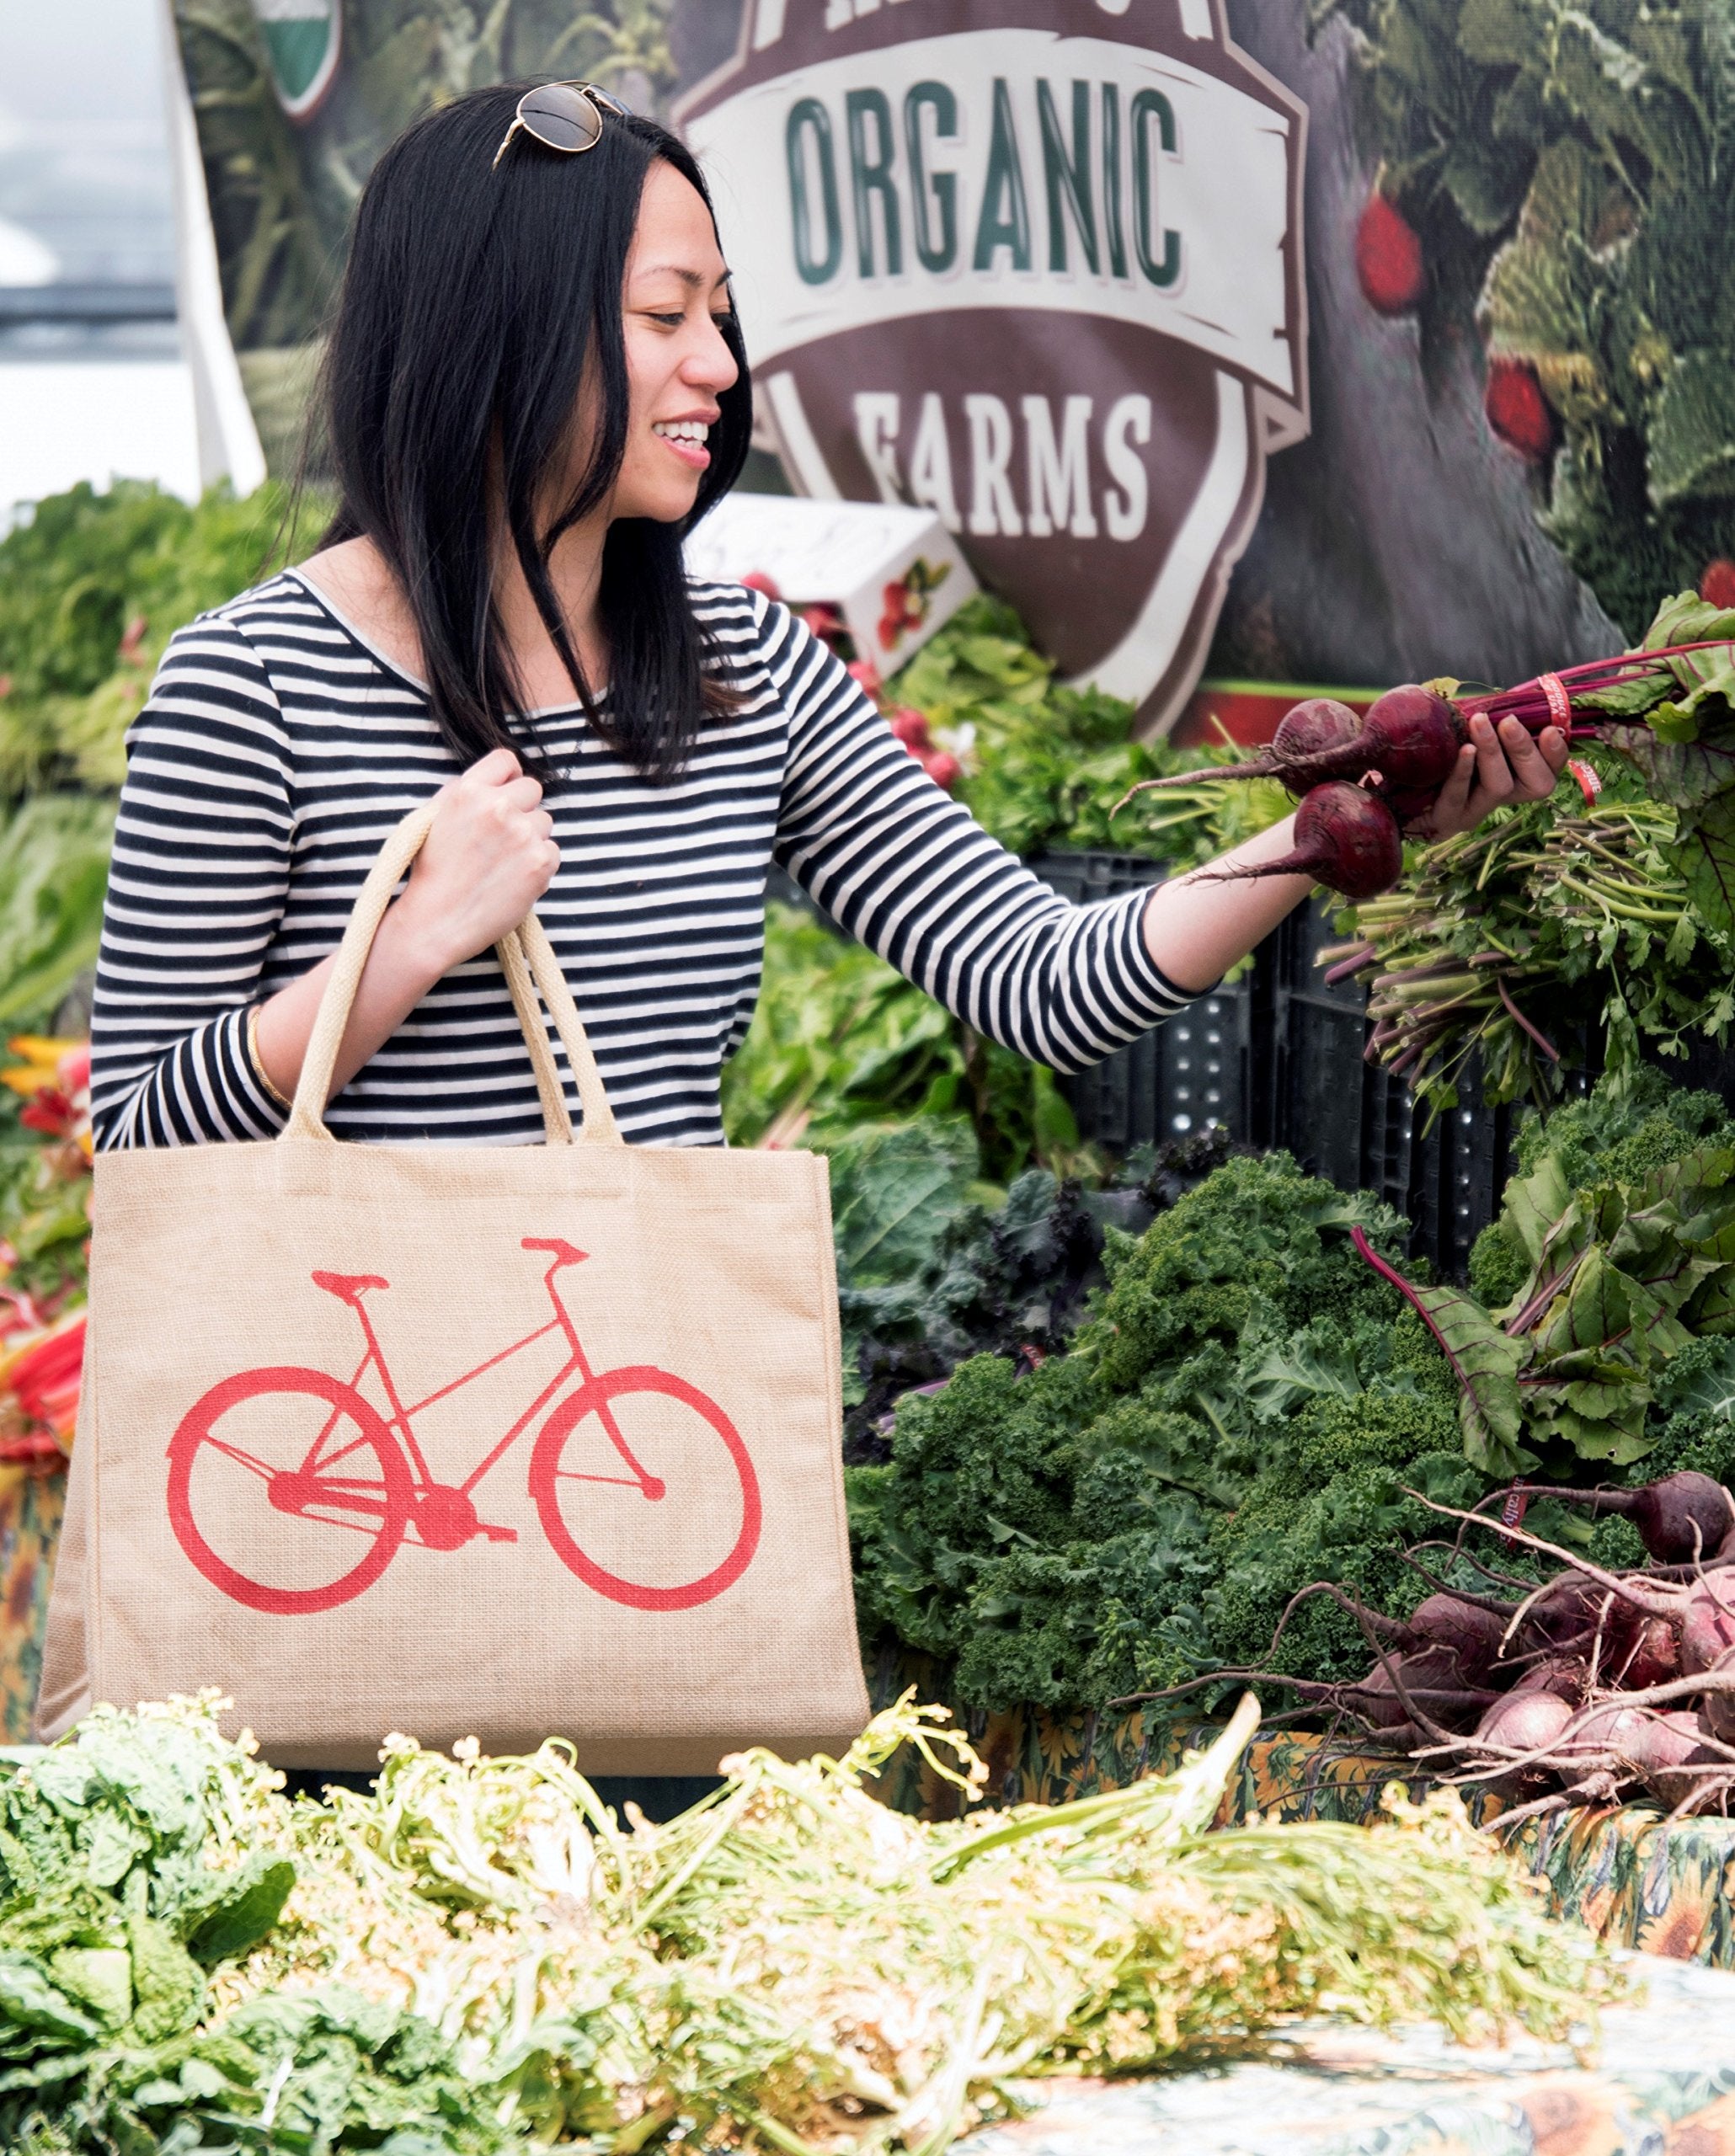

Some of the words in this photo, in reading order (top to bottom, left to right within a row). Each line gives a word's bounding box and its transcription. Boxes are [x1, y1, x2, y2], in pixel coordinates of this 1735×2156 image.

[784, 76, 1183, 291] ORGANIC
[853, 391, 1152, 542] FARMS
[1547, 695, 1559, 715] USA
